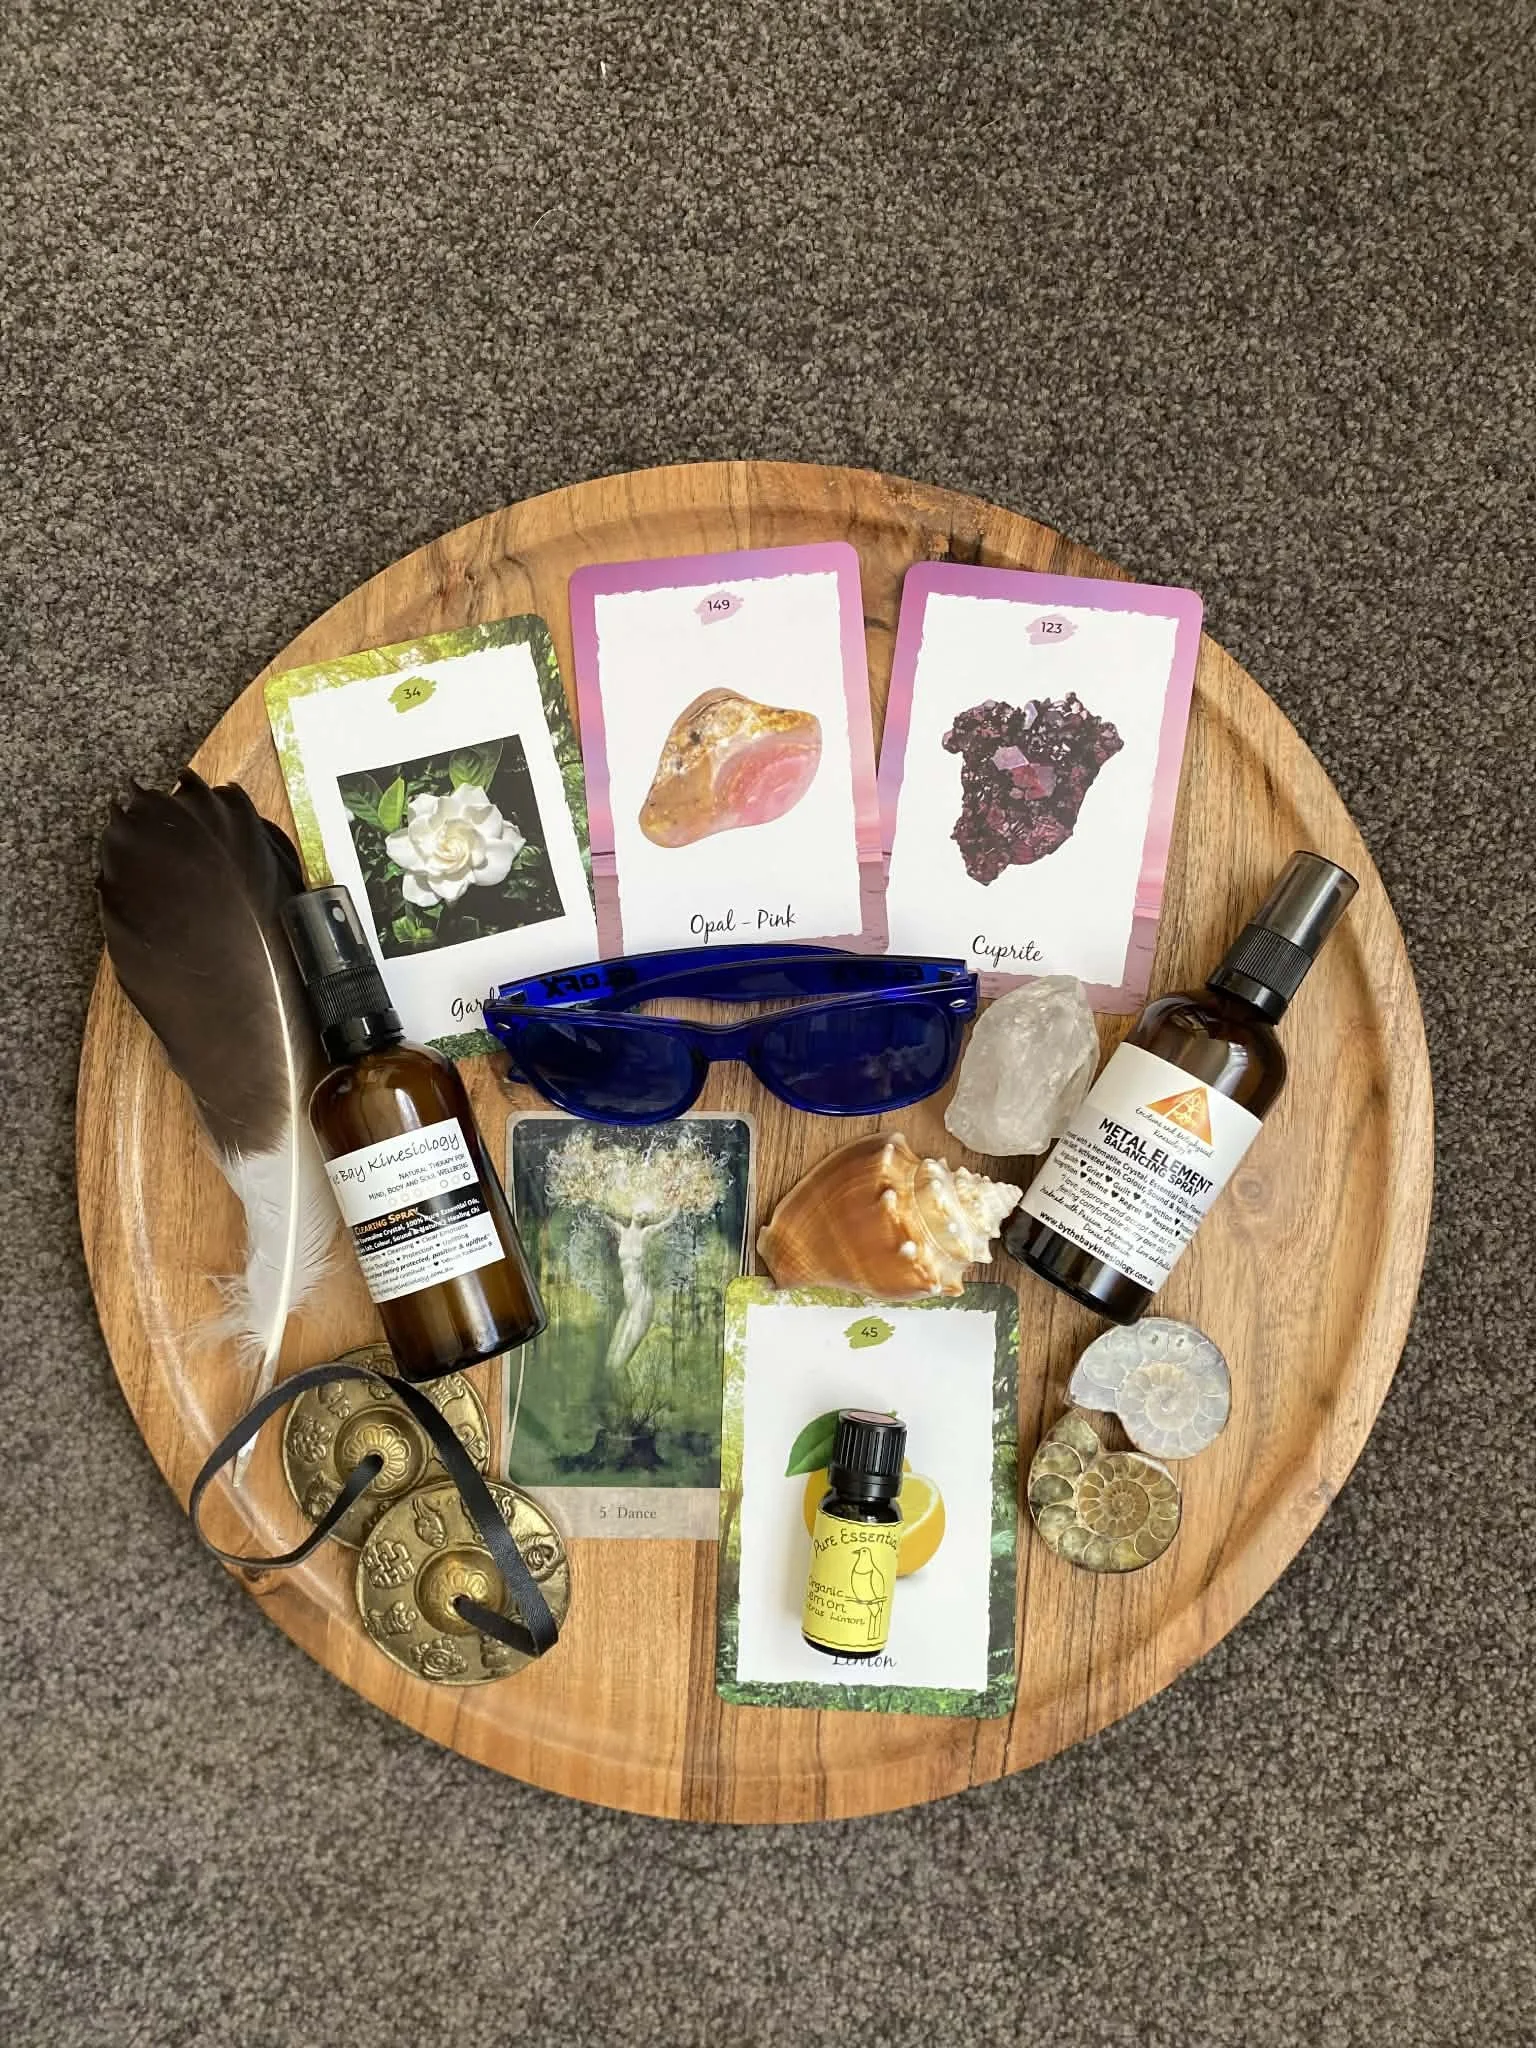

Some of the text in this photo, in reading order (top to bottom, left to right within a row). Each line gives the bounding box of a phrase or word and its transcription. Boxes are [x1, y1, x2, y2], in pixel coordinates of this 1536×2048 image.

[707, 599, 730, 612] 149
[1041, 621, 1063, 634] 123
[402, 687, 422, 700] 34
[690, 908, 737, 945] Opal
[757, 904, 797, 929] Pink
[972, 934, 1044, 968] Cuprite
[338, 1132, 460, 1187] Bay Kinesiology
[1098, 1117, 1214, 1194] METAL ELEMENT
[1102, 1134, 1199, 1198] BALANCING SPRAY
[1085, 1165, 1104, 1180] Grief
[1111, 1181, 1131, 1196] Guilt
[1091, 1144, 1122, 1166] Hematite
[1120, 1162, 1149, 1183] Crystal,
[1148, 1178, 1178, 1201] Essential
[1104, 1162, 1122, 1177] with
[1120, 1173, 1148, 1194] Colour,
[1085, 1176, 1109, 1194] Refine
[1117, 1197, 1142, 1215] Regret
[387, 1206, 420, 1224] SPRAY
[860, 1326, 879, 1338] 45
[617, 1506, 657, 1519] Dance
[813, 1535, 838, 1558] Pure
